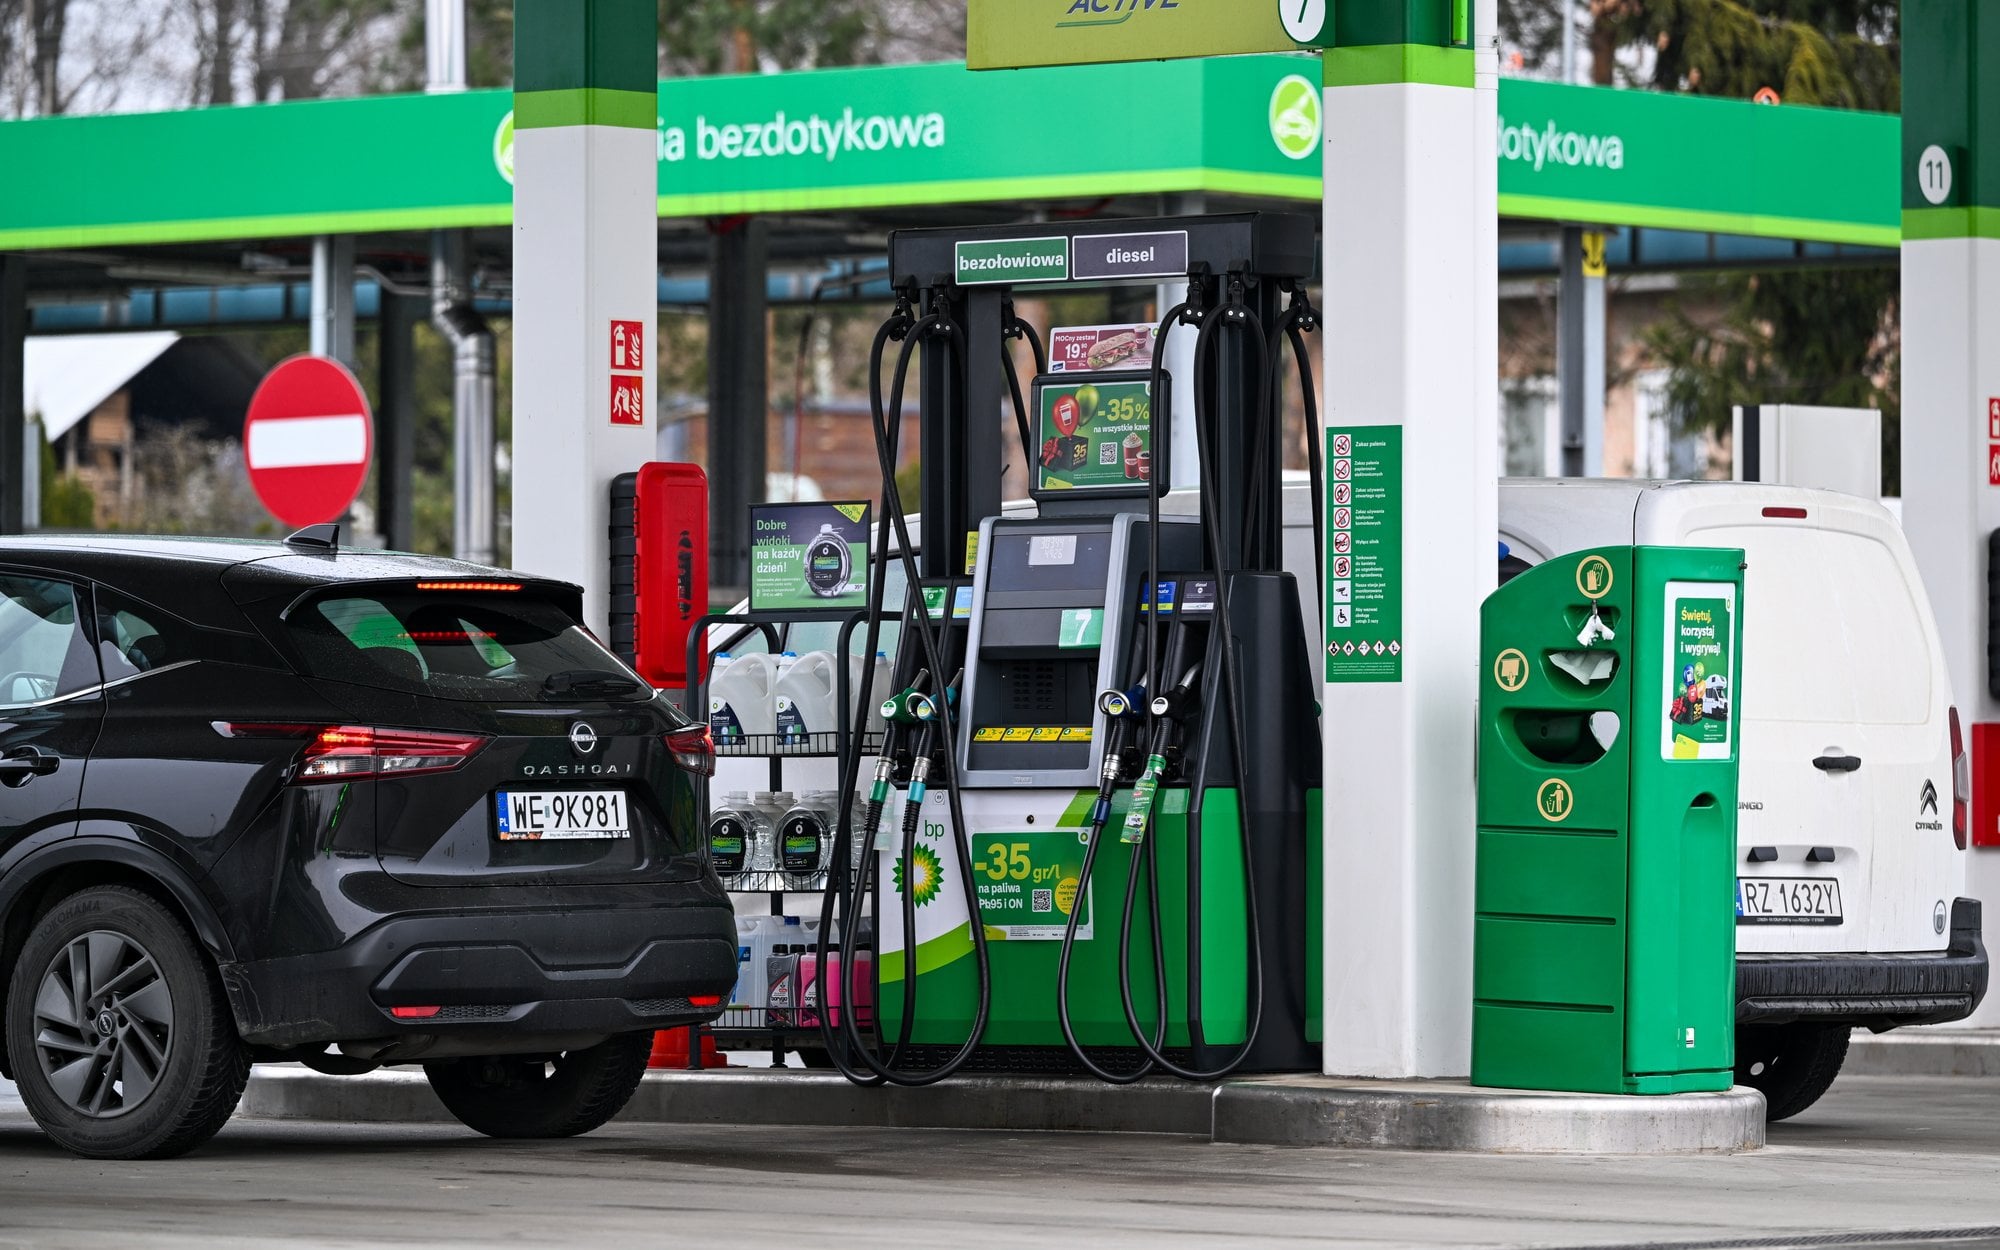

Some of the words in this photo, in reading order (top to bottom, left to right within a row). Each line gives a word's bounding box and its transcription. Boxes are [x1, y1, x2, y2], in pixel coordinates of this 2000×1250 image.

[696, 106, 946, 162] bezdotykowa
[1926, 160, 1943, 190] 11
[959, 253, 1064, 271] bezołowiowa
[1106, 246, 1155, 264] diesel
[1065, 343, 1081, 359] 19
[1102, 423, 1133, 434] wszystkie
[1074, 444, 1088, 459] 35
[756, 519, 787, 531] Dobre
[756, 535, 791, 546] widoki
[756, 550, 769, 559] na
[772, 547, 801, 561] każdy
[756, 562, 787, 573] dzień!
[1681, 606, 1712, 624] Świętuj,
[1075, 608, 1092, 645] 7
[1681, 625, 1715, 639] korzystaj
[1685, 642, 1721, 656] wygrywaj!
[523, 764, 631, 776] QASHQAI
[513, 796, 544, 829] WE
[552, 794, 620, 828] 9K981
[500, 818, 509, 826] PL
[924, 819, 945, 841] bp
[974, 842, 1031, 880] -35
[1032, 864, 1060, 884] gr/l
[979, 885, 990, 893] na
[991, 882, 1021, 895] paliwa
[1008, 898, 1023, 909] ON
[1745, 883, 1772, 913] RZ
[1780, 883, 1833, 914] 1632Y
